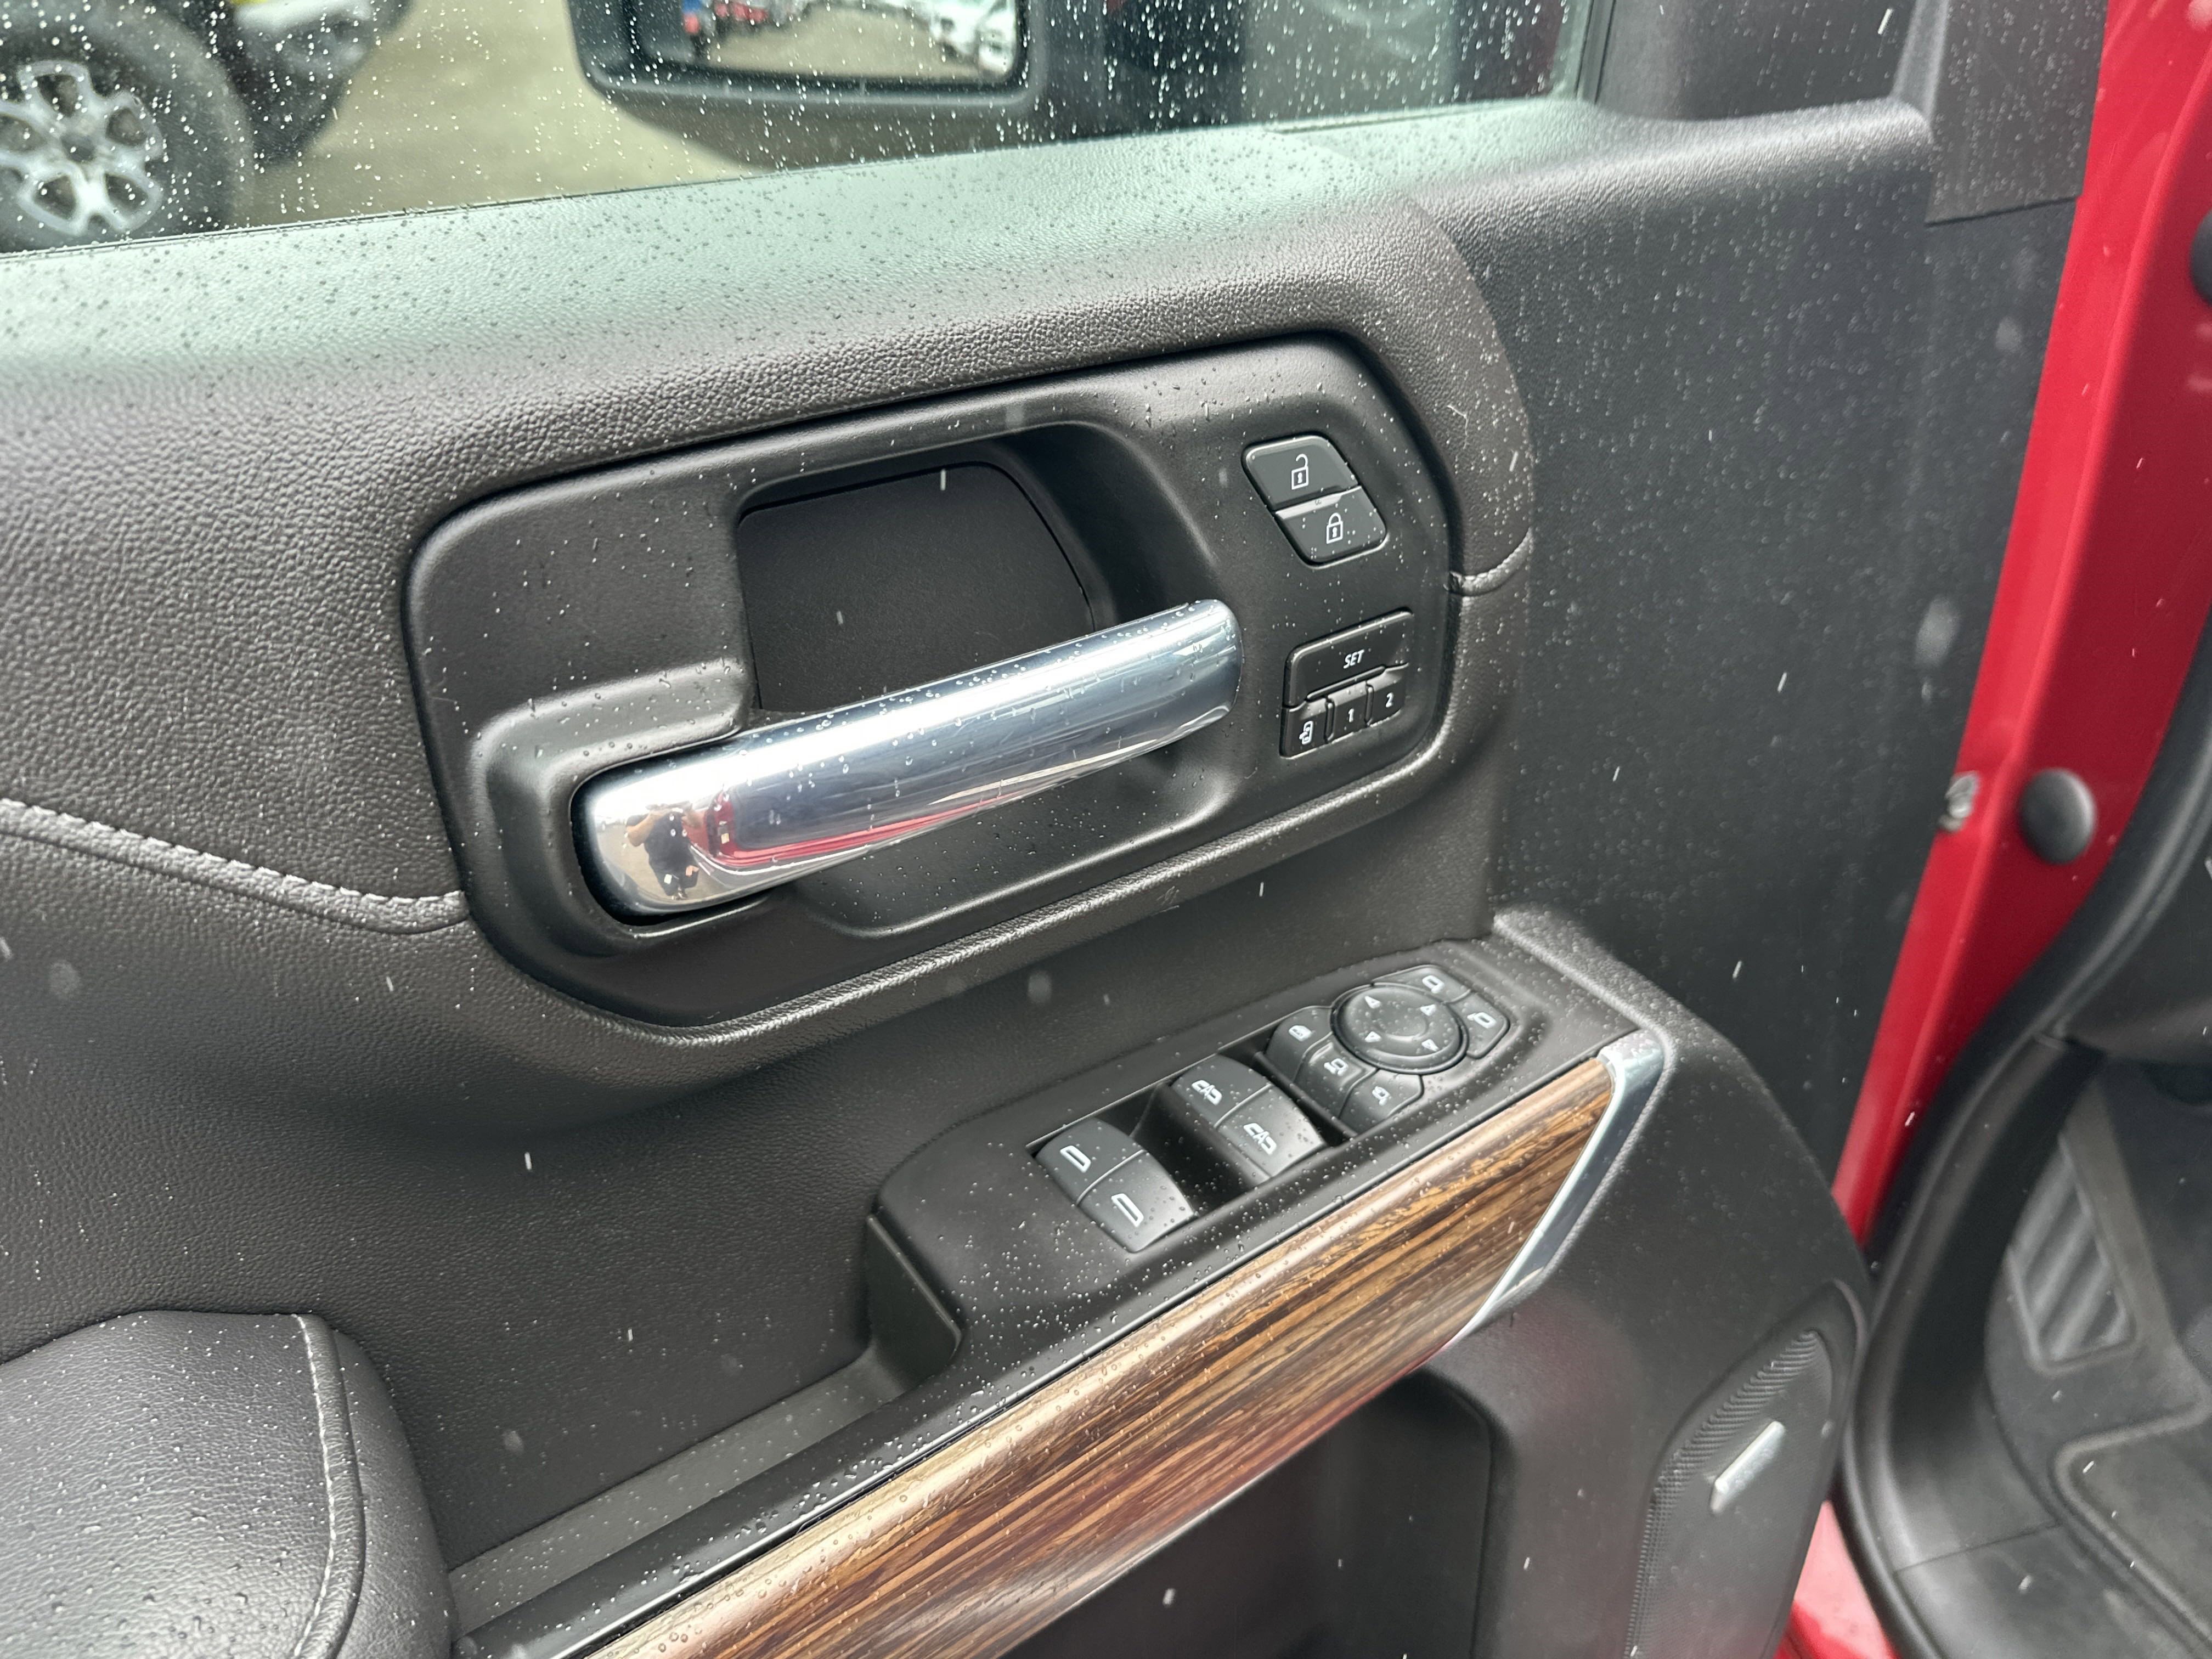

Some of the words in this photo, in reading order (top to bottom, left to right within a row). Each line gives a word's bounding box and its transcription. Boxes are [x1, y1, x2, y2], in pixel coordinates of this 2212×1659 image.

[1343, 649, 1365, 669] SET
[1385, 692, 1394, 708] 2
[1348, 708, 1355, 723] 1
